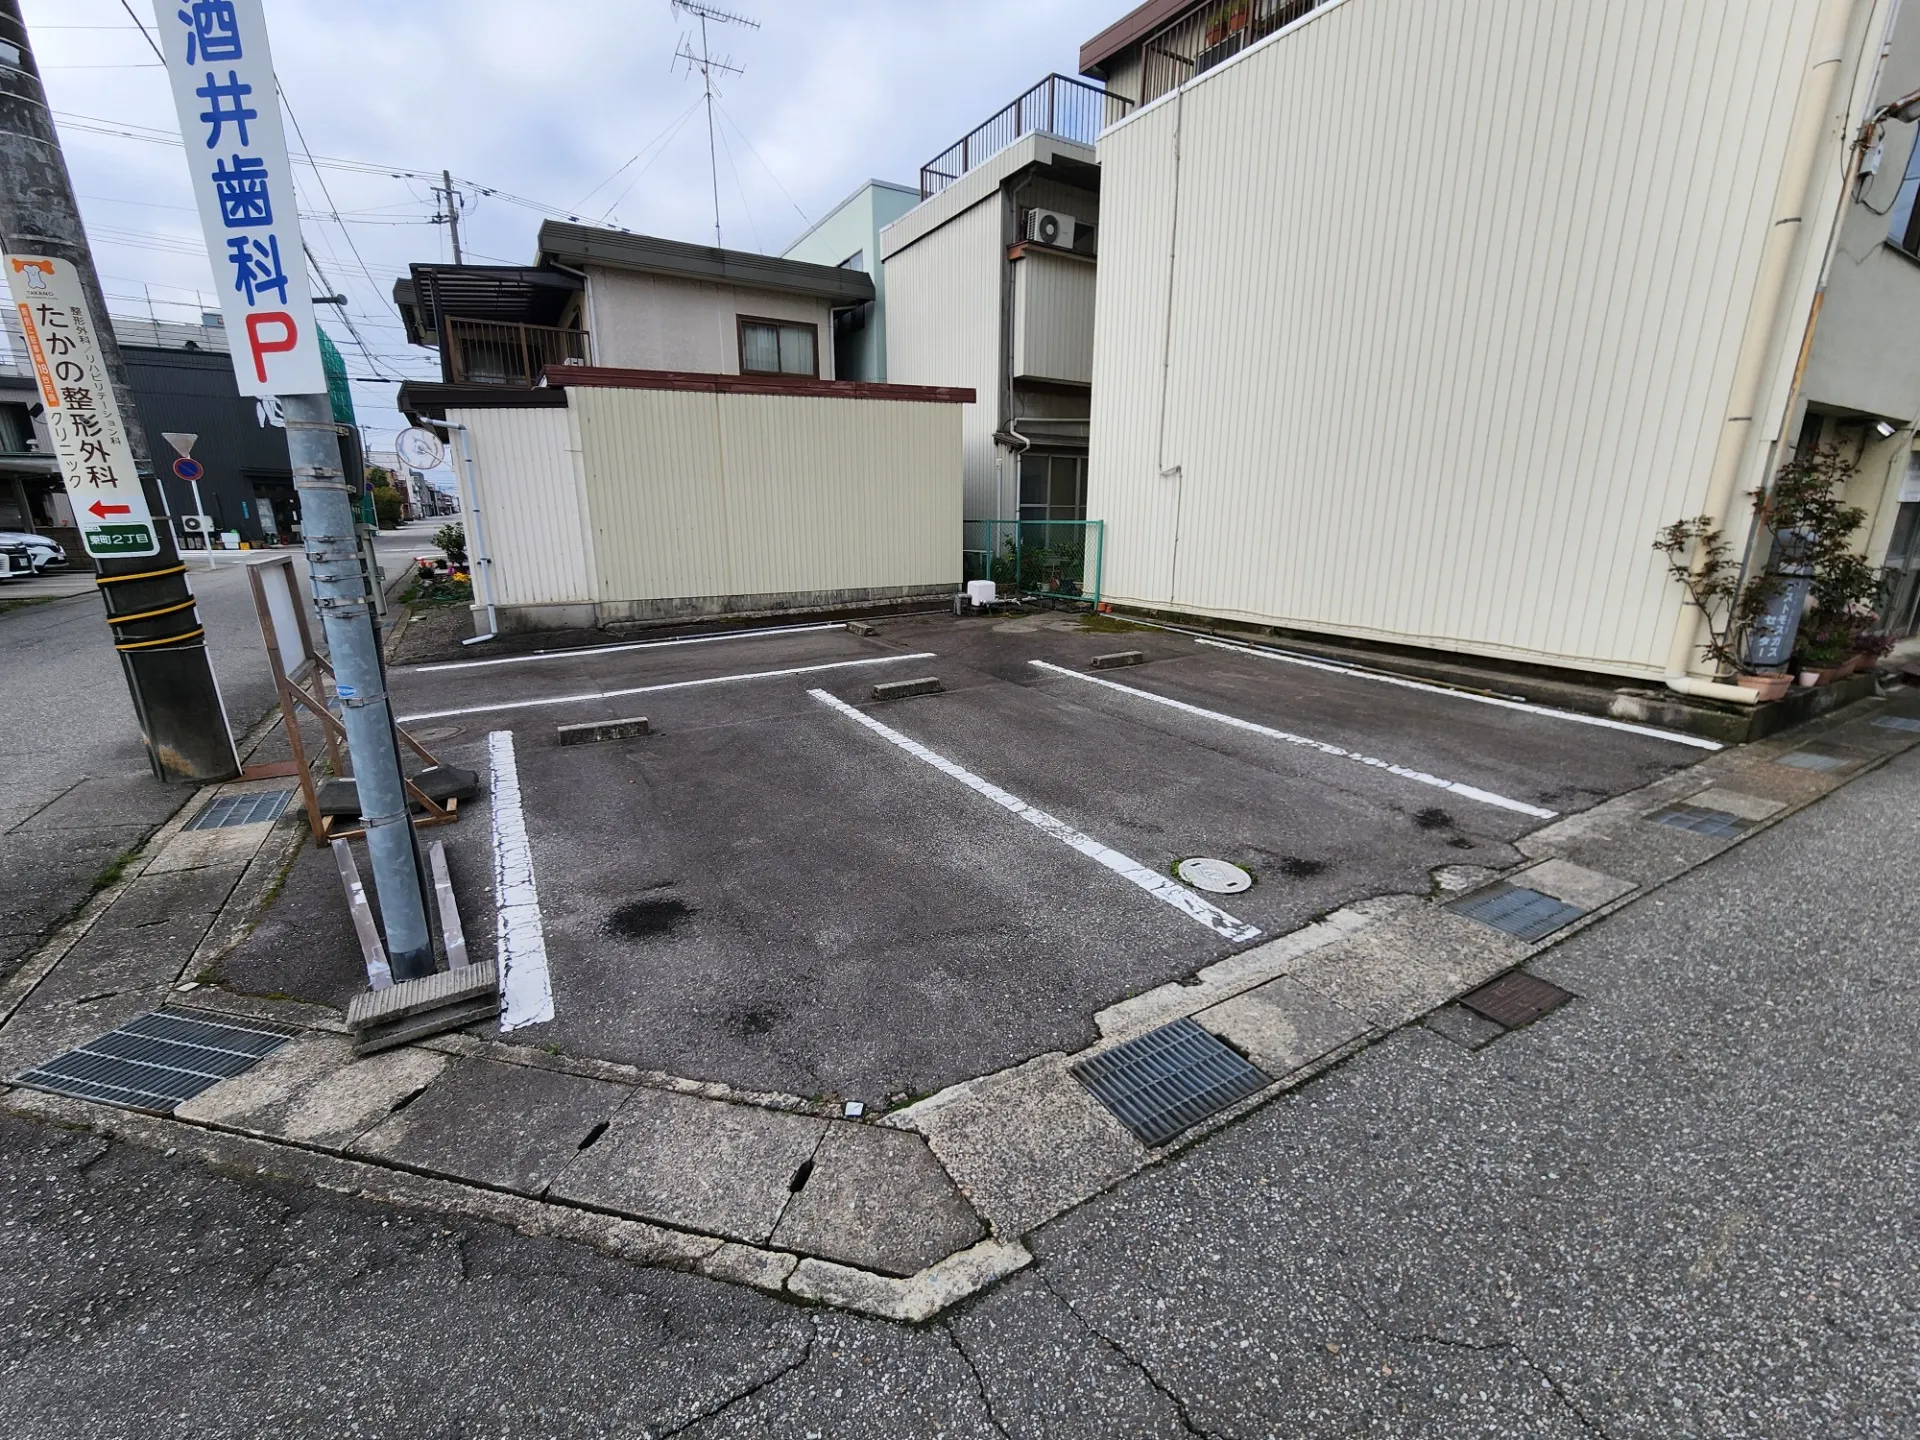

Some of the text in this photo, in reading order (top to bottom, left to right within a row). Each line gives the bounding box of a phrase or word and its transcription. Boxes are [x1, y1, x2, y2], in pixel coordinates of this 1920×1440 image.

[36, 303, 119, 489] たかの整形外科
[51, 412, 82, 489] クリニック
[1758, 614, 1777, 657] セター
